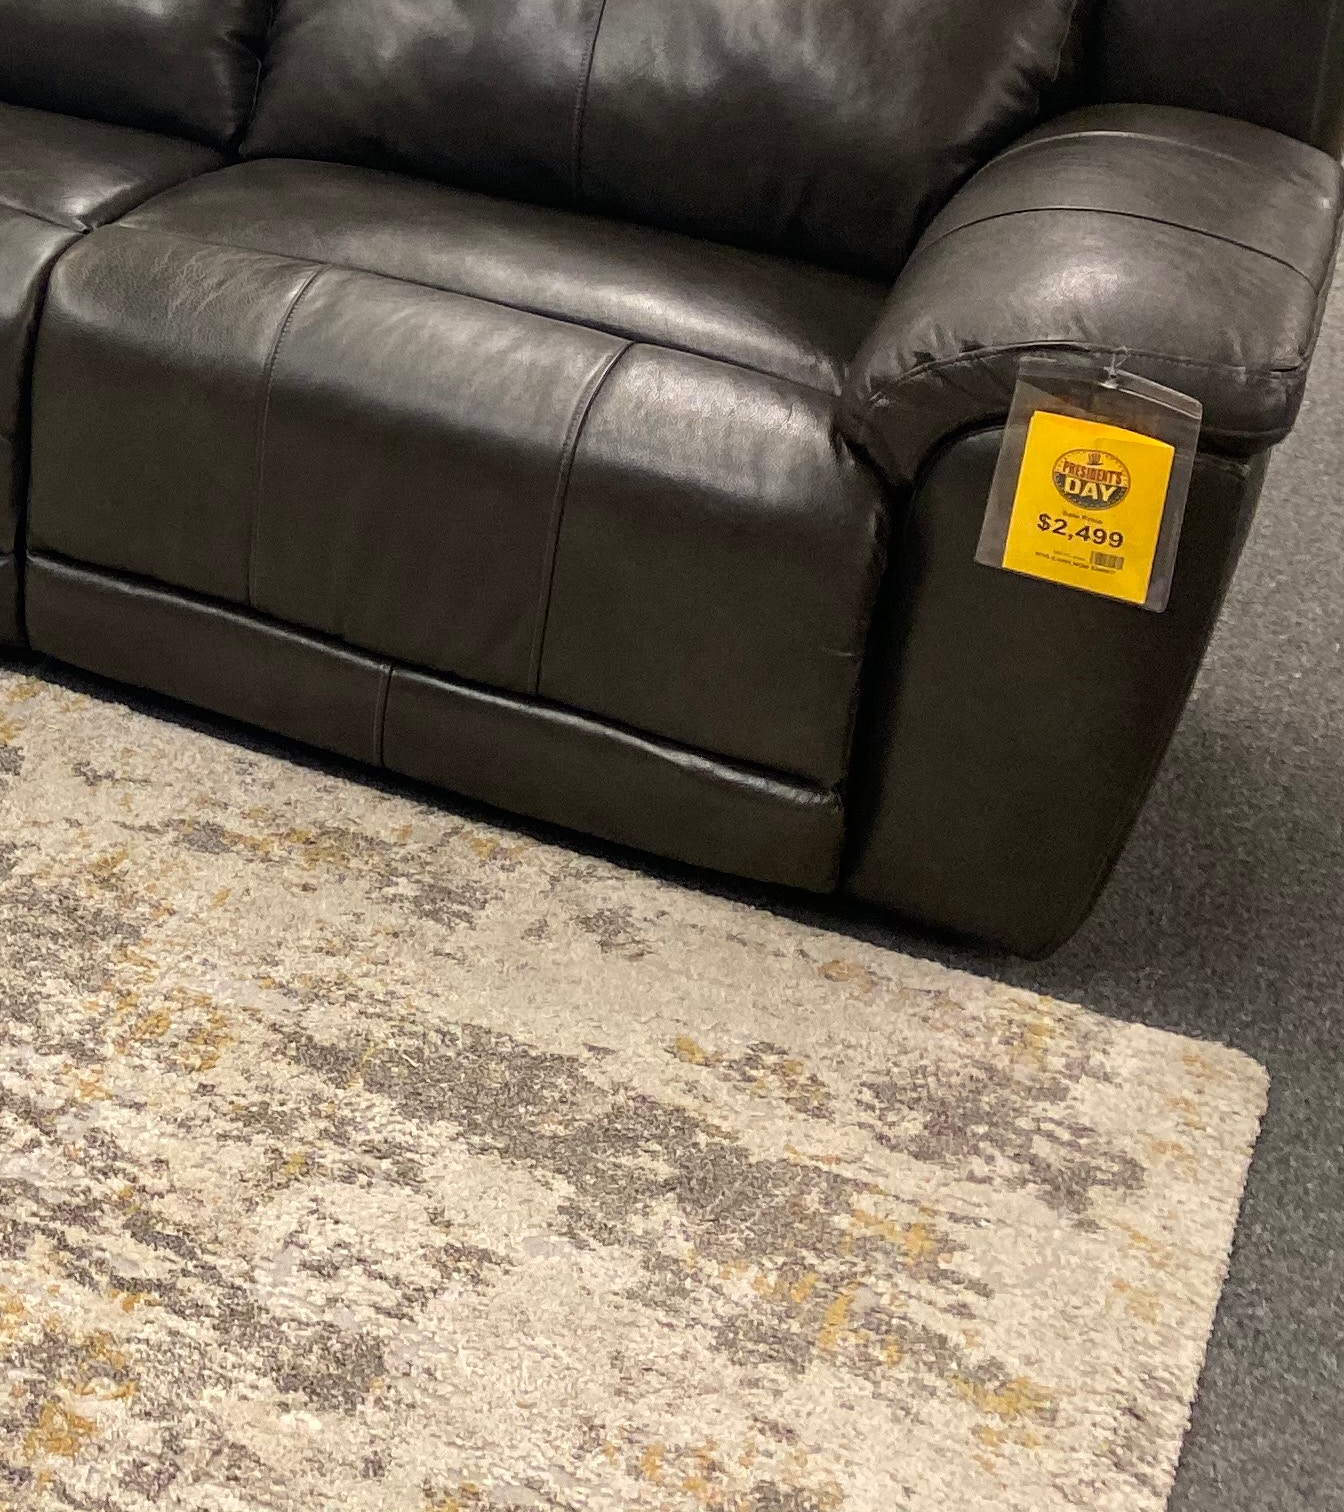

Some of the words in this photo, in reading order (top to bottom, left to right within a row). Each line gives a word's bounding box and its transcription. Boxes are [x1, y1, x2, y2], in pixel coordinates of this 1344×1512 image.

[1063, 461, 1122, 485] PRESIDENT'S
[1064, 475, 1118, 502] DAY
[1037, 513, 1124, 548] $2,499
